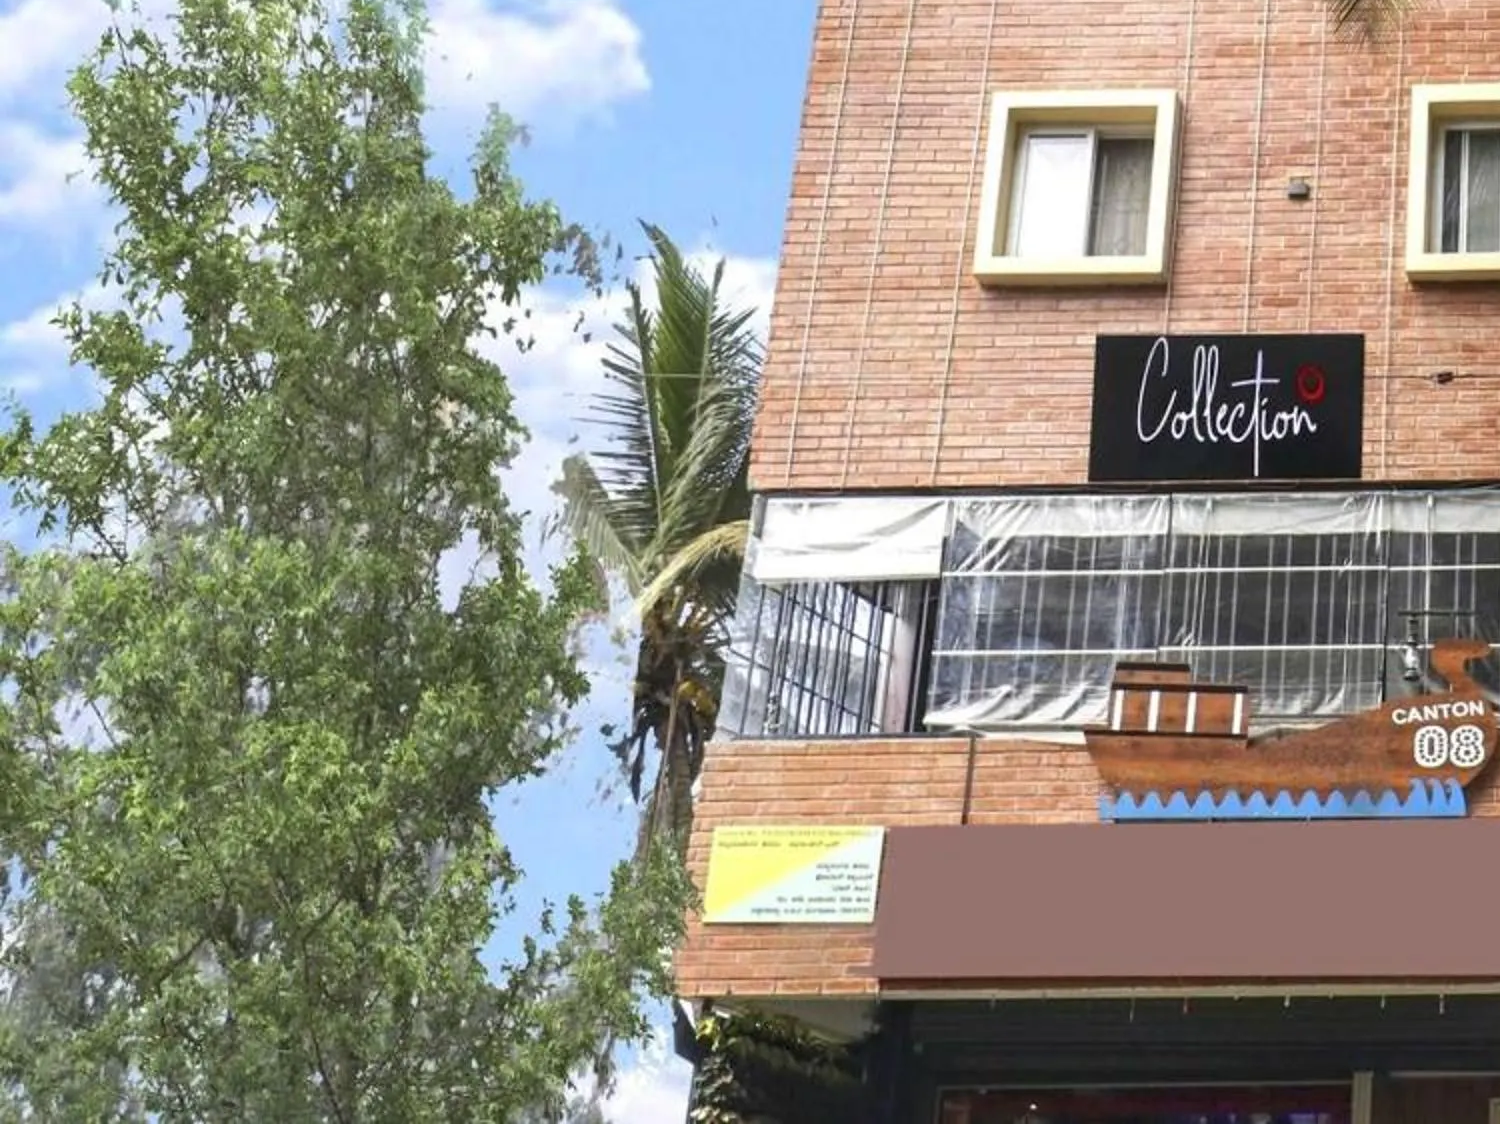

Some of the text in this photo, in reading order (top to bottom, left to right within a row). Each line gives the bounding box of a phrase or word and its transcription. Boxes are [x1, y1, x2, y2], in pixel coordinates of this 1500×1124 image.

[1137, 336, 1317, 477] Collection
[1391, 700, 1485, 725] CANTON
[1413, 724, 1486, 768] 08
